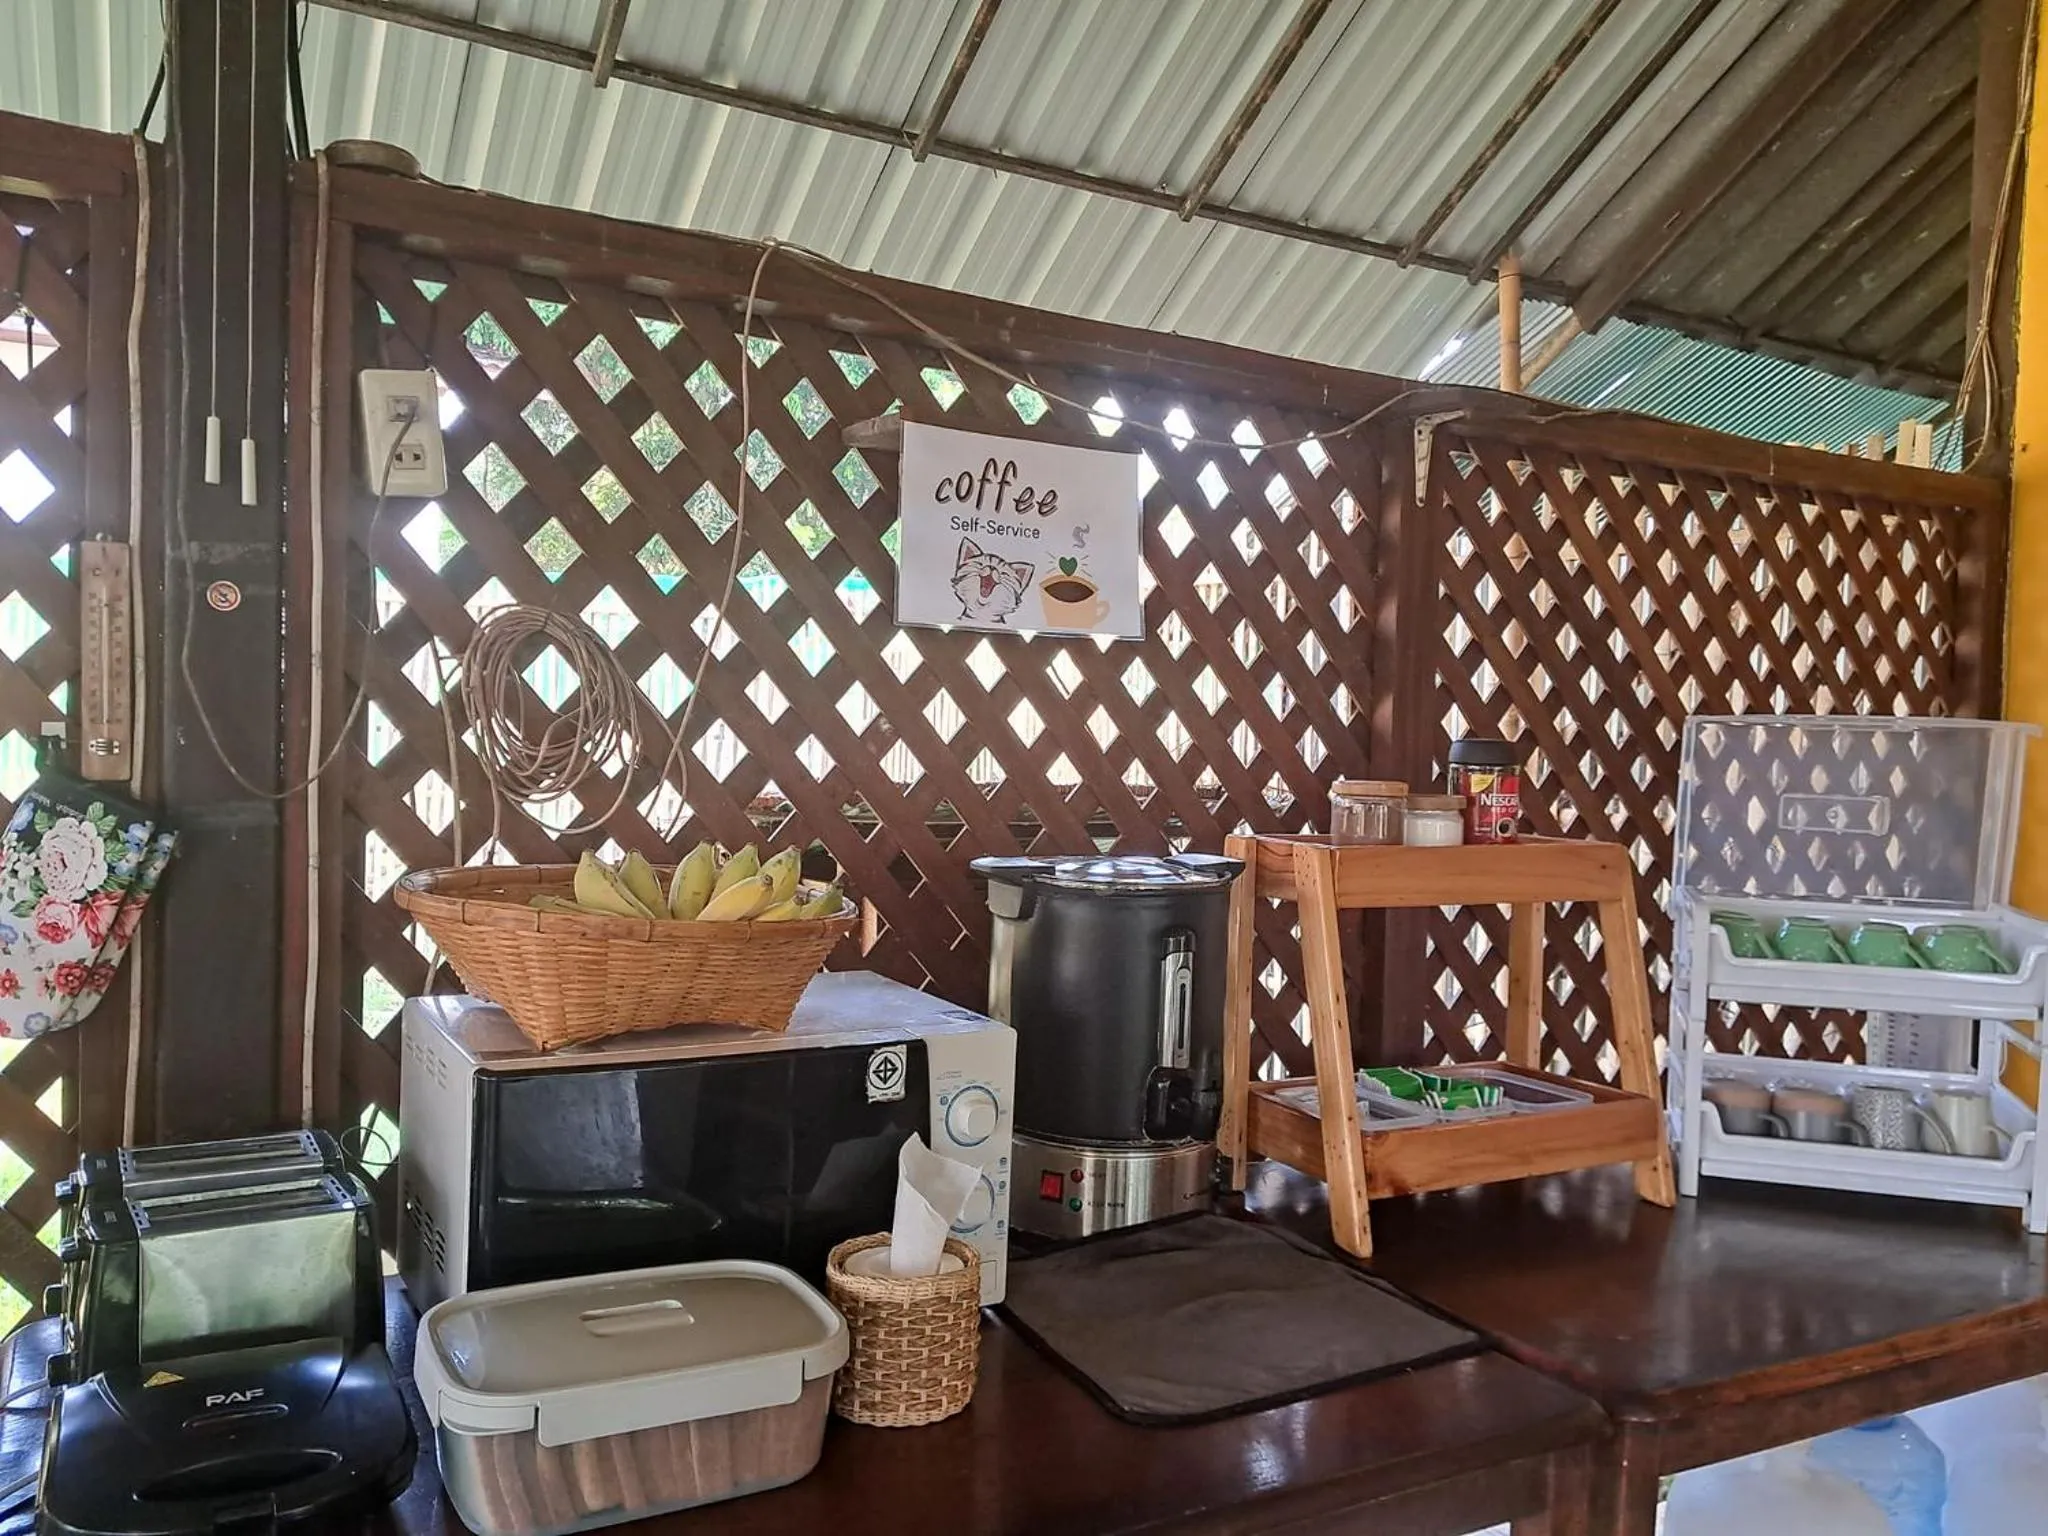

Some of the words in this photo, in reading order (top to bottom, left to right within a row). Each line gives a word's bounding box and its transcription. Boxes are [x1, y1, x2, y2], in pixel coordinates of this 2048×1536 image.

[935, 457, 1059, 517] coffee
[950, 515, 1040, 539] Self-Service
[206, 1387, 265, 1408] RAF
